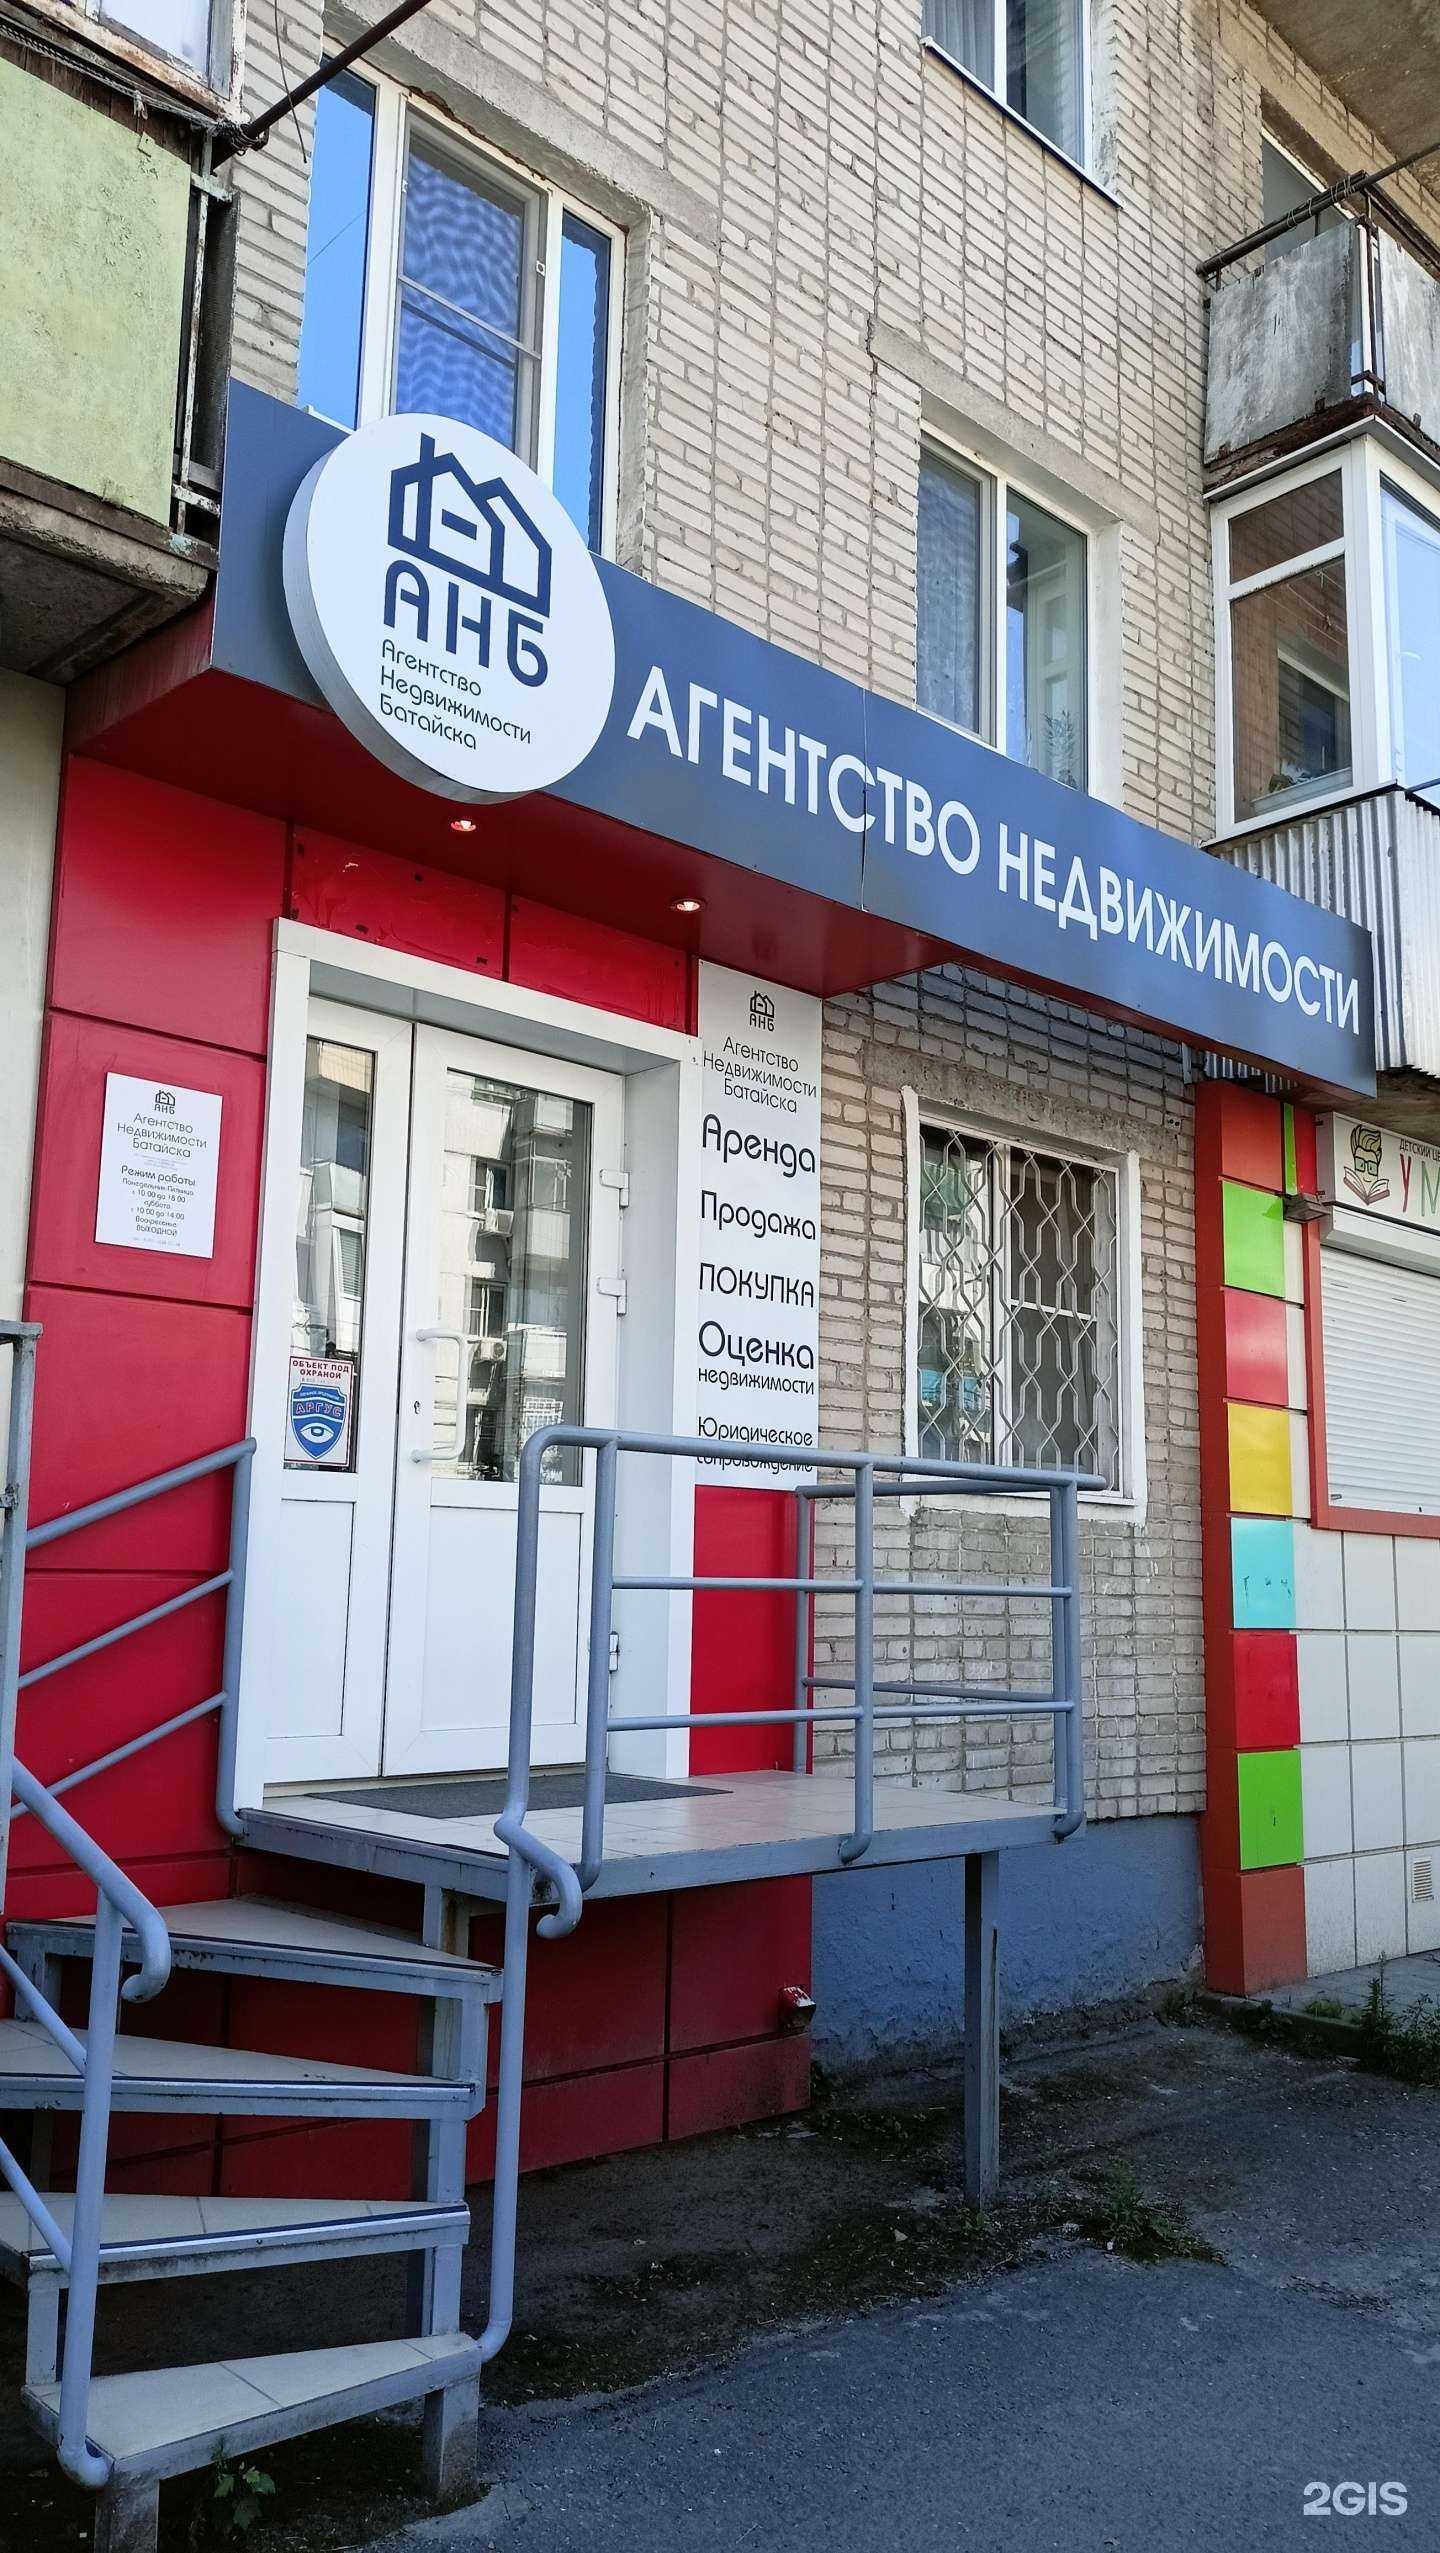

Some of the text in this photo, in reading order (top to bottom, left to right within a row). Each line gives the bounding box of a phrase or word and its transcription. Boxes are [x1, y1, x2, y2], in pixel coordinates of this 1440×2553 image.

[383, 559, 549, 688] АНБ
[382, 639, 482, 697] Агентство
[380, 666, 532, 745] Недвижимости
[380, 693, 477, 750] Батайска
[626, 665, 1360, 1036] АГЕНТСТВО НЕДВИЖИМОСТИ
[750, 1013, 775, 1032] АНБ
[723, 1036, 799, 1072] Агентство
[703, 1050, 817, 1098] Недвижимости
[154, 1103, 176, 1115] АНБ
[724, 1079, 798, 1113] Батайска
[117, 1122, 208, 1149] Недвижимости
[133, 1112, 194, 1134] Агентство
[132, 1138, 191, 1158] Батайска
[702, 1113, 816, 1178] Аренда
[121, 1165, 196, 1187] Режим работы
[701, 1189, 816, 1241] Продажа
[699, 1262, 814, 1308] ПОКУПКА
[698, 1320, 814, 1370] Оценка
[292, 1360, 349, 1373] ОБЪЕКТ ПОД
[300, 1368, 341, 1379] ОХРАНОЙ
[698, 1368, 815, 1395] недвижимости
[295, 1401, 342, 1417] АРГУС
[698, 1416, 813, 1446] Юридическое
